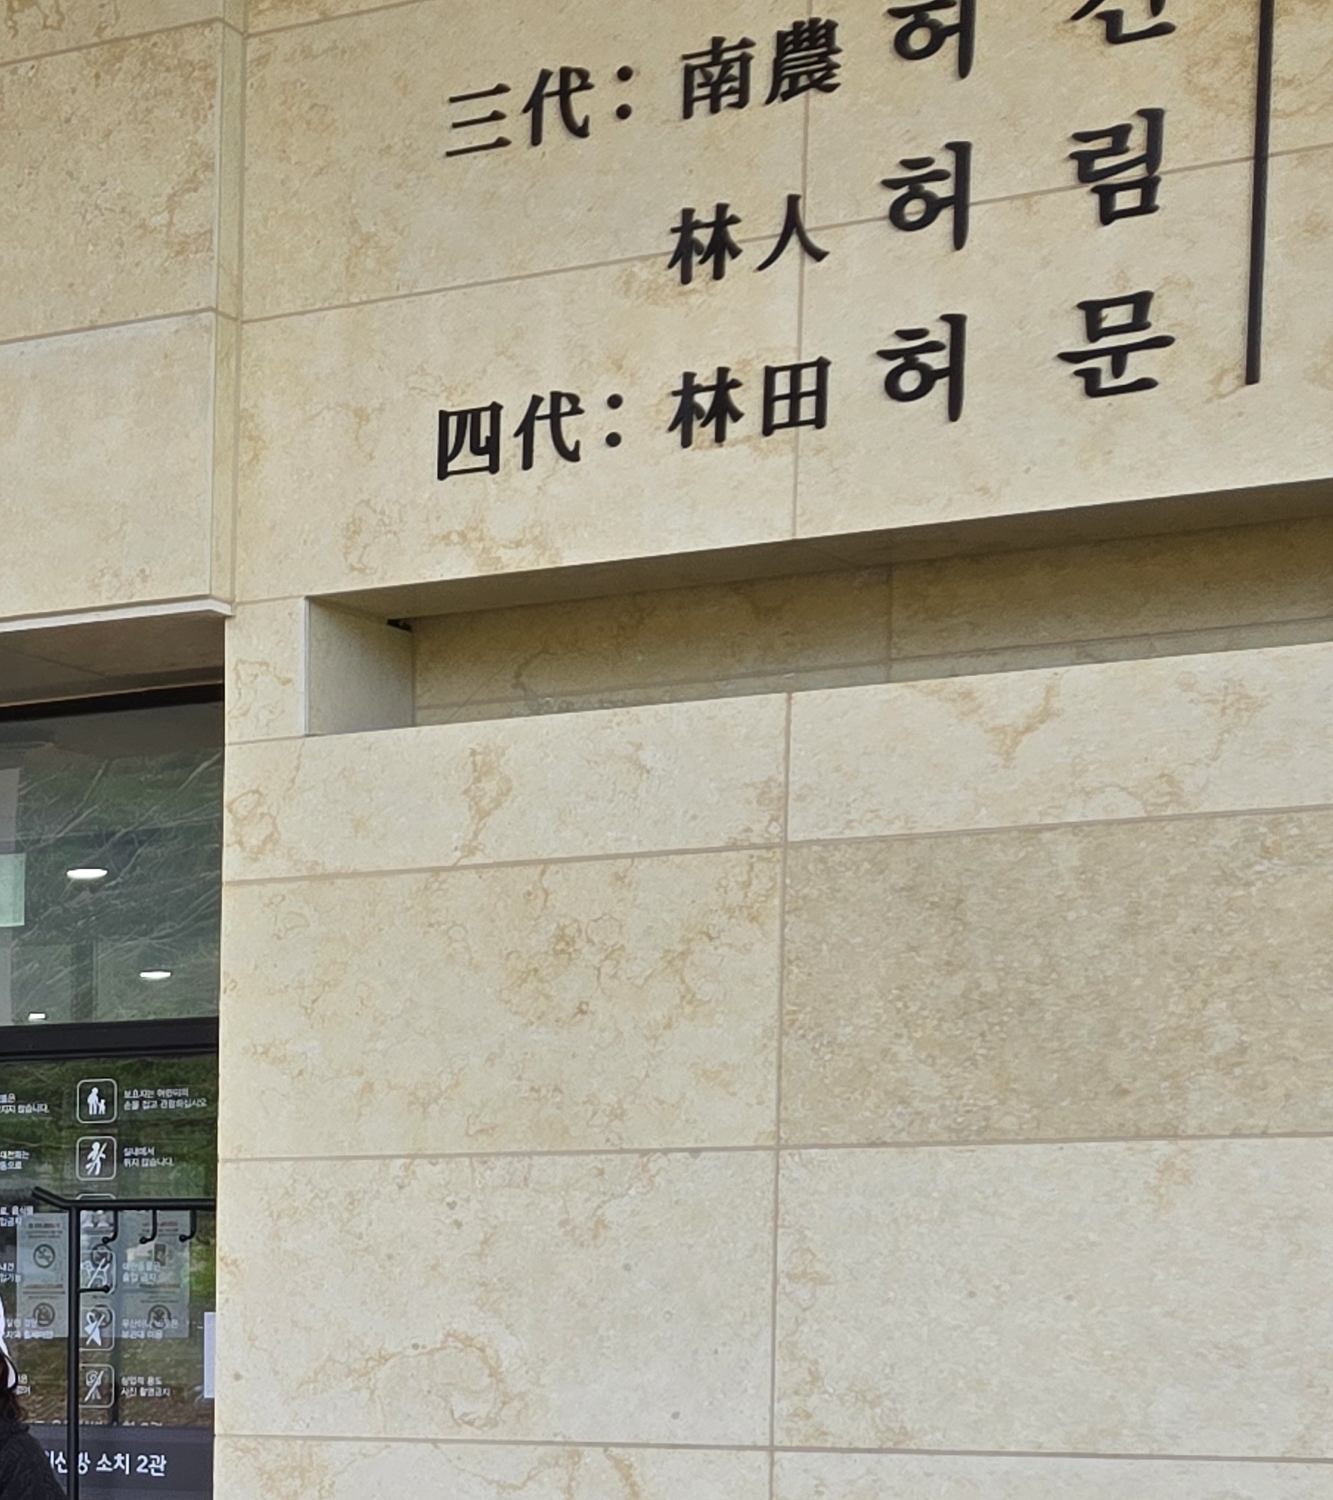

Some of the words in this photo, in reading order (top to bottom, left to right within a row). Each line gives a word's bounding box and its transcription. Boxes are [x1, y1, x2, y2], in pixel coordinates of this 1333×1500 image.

[444, 65, 634, 158] 三代:
[679, 17, 843, 121] 南農
[667, 194, 830, 285] 林人
[880, 140, 974, 252] 허
[1069, 108, 1167, 227] 림
[436, 390, 623, 481] 四代:
[667, 355, 832, 449] 林田
[876, 314, 968, 422] 허
[1058, 290, 1177, 399] 문
[95, 1452, 130, 1475] 소치
[136, 1454, 168, 1477] 2관
